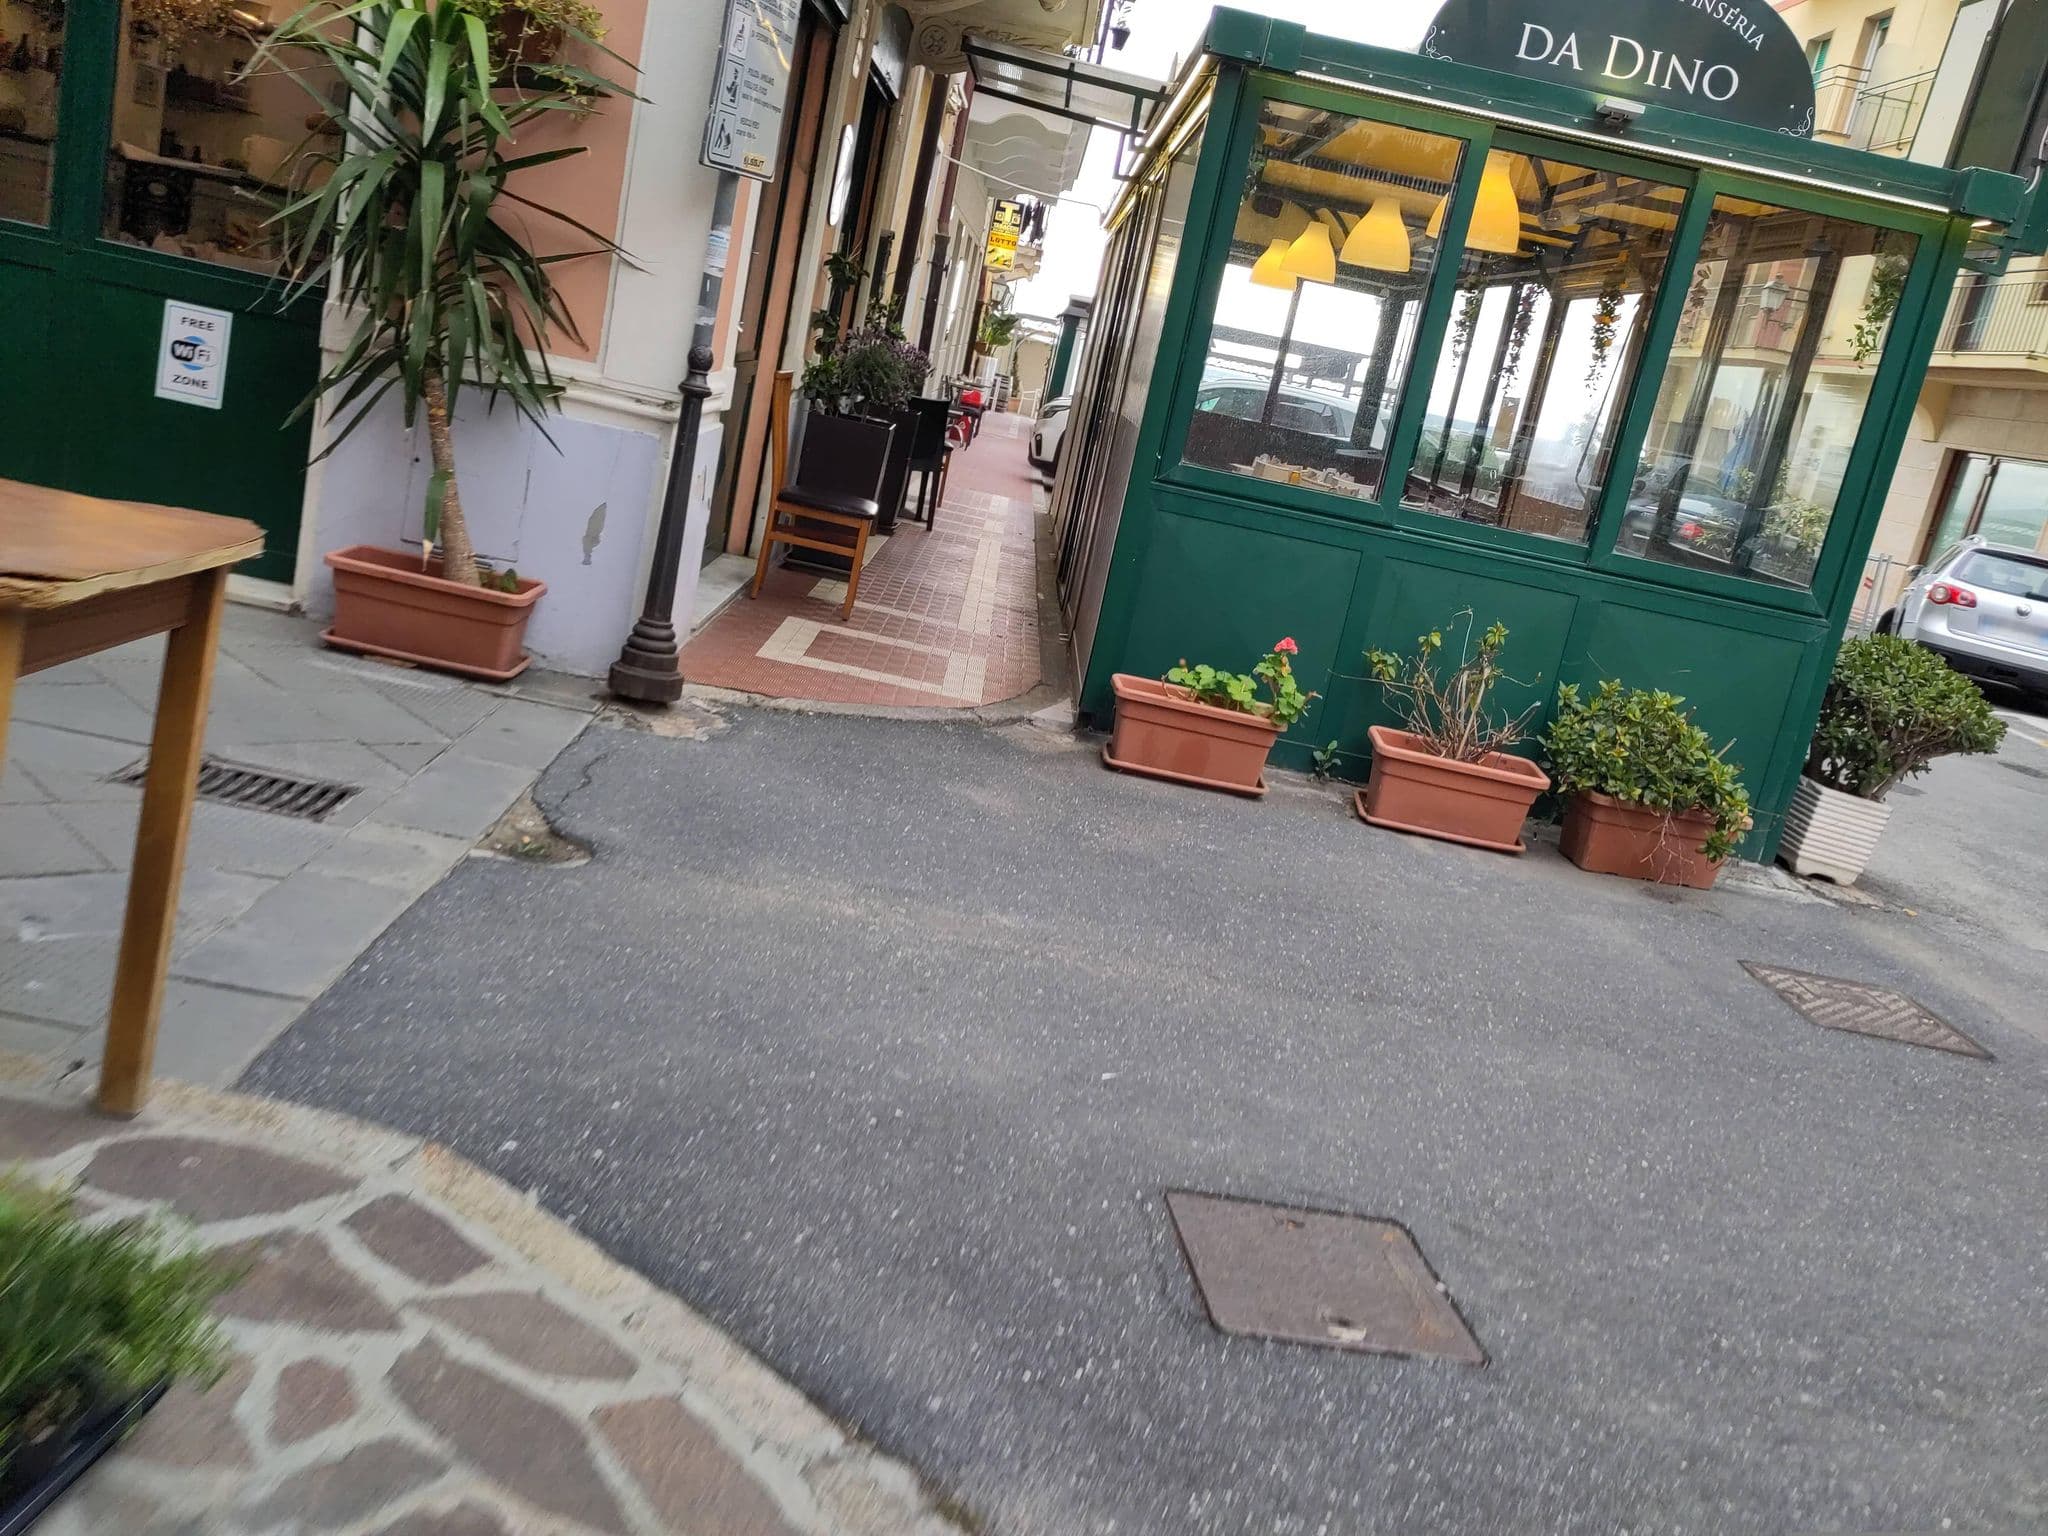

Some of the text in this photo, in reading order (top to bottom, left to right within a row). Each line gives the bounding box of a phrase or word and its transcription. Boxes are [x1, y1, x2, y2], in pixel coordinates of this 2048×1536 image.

[1679, 0, 1765, 51] INSERIA
[1514, 22, 1740, 101] DA DINO
[990, 236, 1017, 247] LOTTO
[181, 317, 215, 331] FREE
[173, 375, 208, 389] ZONE
